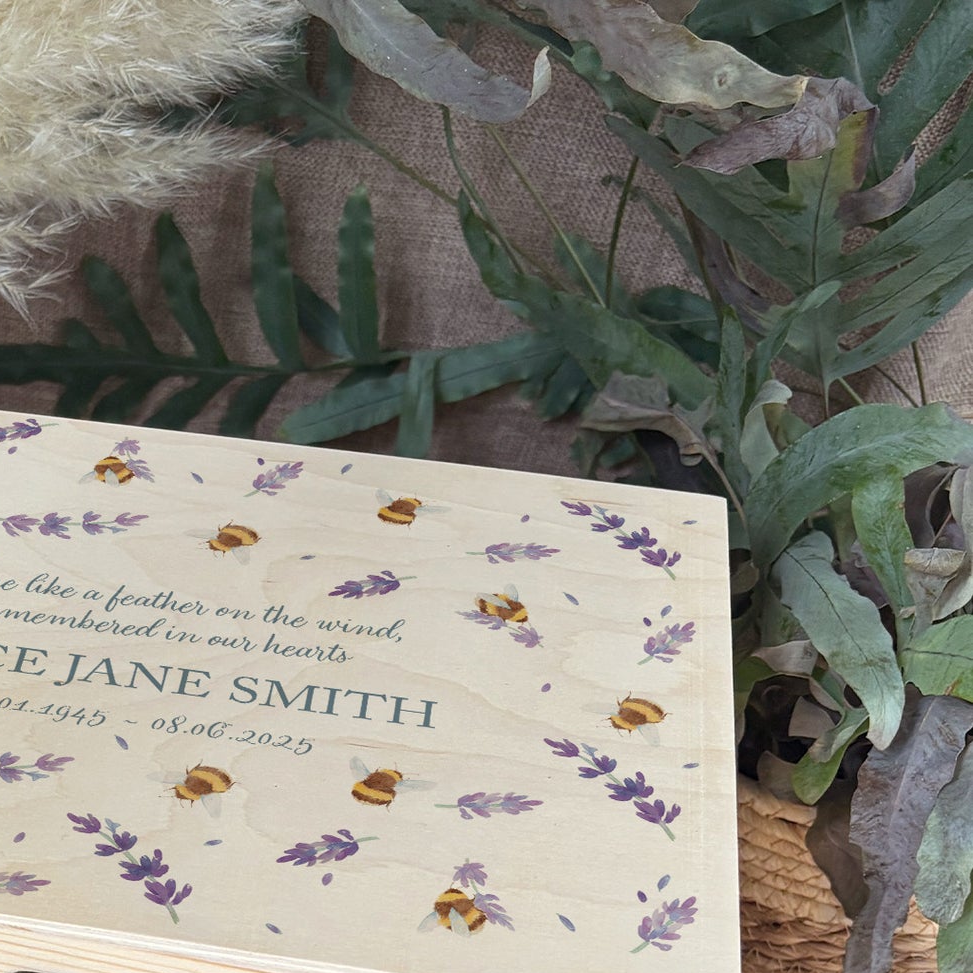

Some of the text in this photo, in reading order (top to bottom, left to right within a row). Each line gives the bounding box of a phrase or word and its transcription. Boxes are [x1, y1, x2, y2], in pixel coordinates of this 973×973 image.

[25, 571, 78, 600] like
[82, 588, 103, 602] a
[105, 585, 209, 620] feather
[215, 603, 254, 621] on
[262, 604, 309, 630] the
[316, 611, 403, 643] wind,
[165, 622, 203, 644] in
[208, 632, 258, 653] our
[263, 632, 354, 664] hearts
[53, 653, 212, 699] JANE
[228, 676, 439, 729] SMITH
[150, 714, 315, 755] 08.06.2025
